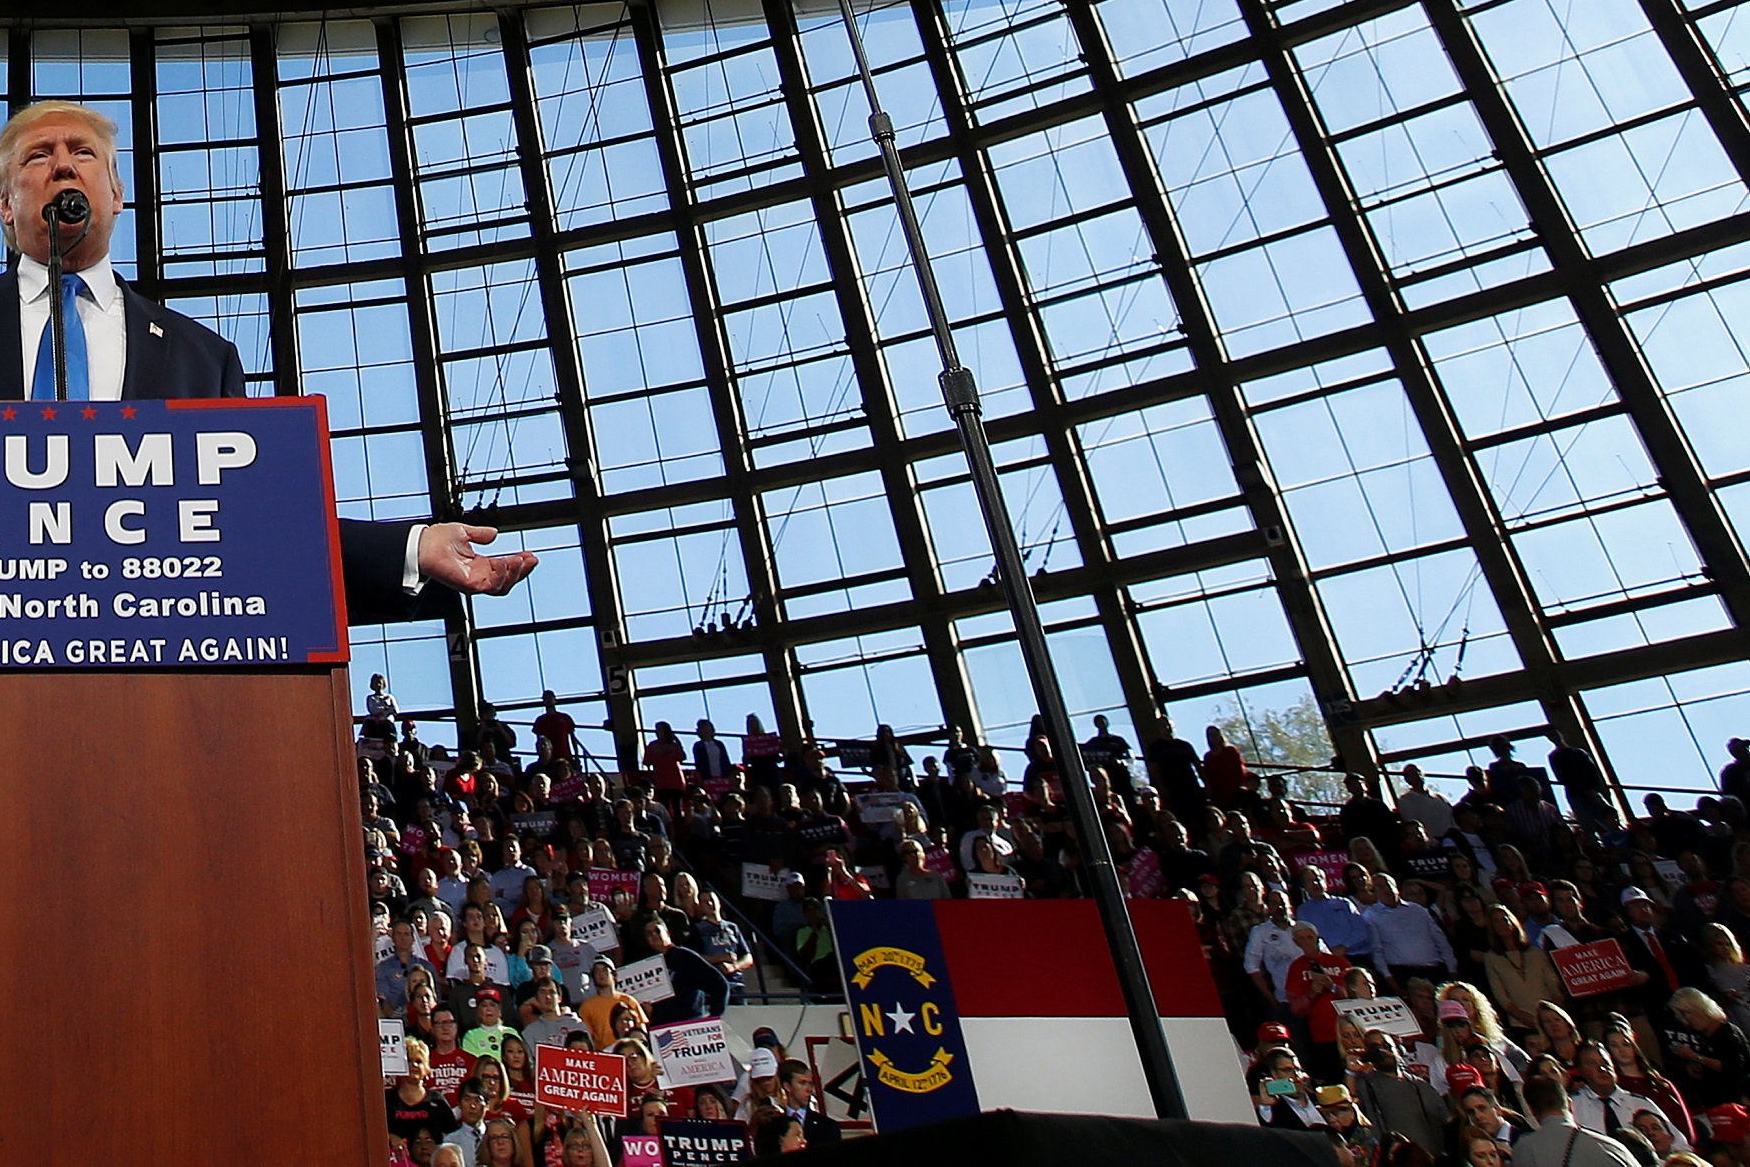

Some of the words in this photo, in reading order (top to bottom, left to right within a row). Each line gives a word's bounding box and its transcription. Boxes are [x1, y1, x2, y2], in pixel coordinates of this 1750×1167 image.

[80, 560, 109, 581] to
[121, 557, 224, 579] 88022
[112, 590, 267, 617] Carolina
[65, 638, 167, 664] GREAT
[177, 637, 289, 663] AGAIN!
[451, 634, 467, 659] 4
[610, 666, 627, 692] 5
[1294, 853, 1349, 866] WOMEN
[1407, 857, 1450, 866] TRUM
[587, 872, 639, 882] WOMEN
[972, 883, 1020, 893] TRUMP
[571, 919, 606, 937] RUMP
[1562, 955, 1626, 976] AMERICA
[617, 967, 663, 989] TRUMP
[859, 1003, 886, 1037] N
[921, 1001, 944, 1036] C
[1364, 1012, 1401, 1023] ENCE
[681, 1025, 722, 1038] VETERANS
[706, 1032, 723, 1041] FOR
[671, 1042, 726, 1059] TRUMP
[565, 1057, 596, 1071] MAKE
[538, 1067, 624, 1092] AMERICA
[543, 1084, 581, 1100] GREAT
[582, 1090, 619, 1105] AGAIN
[823, 1061, 868, 1120] 4
[663, 1135, 745, 1152] TRUMP
[672, 1150, 739, 1162] PENCE
